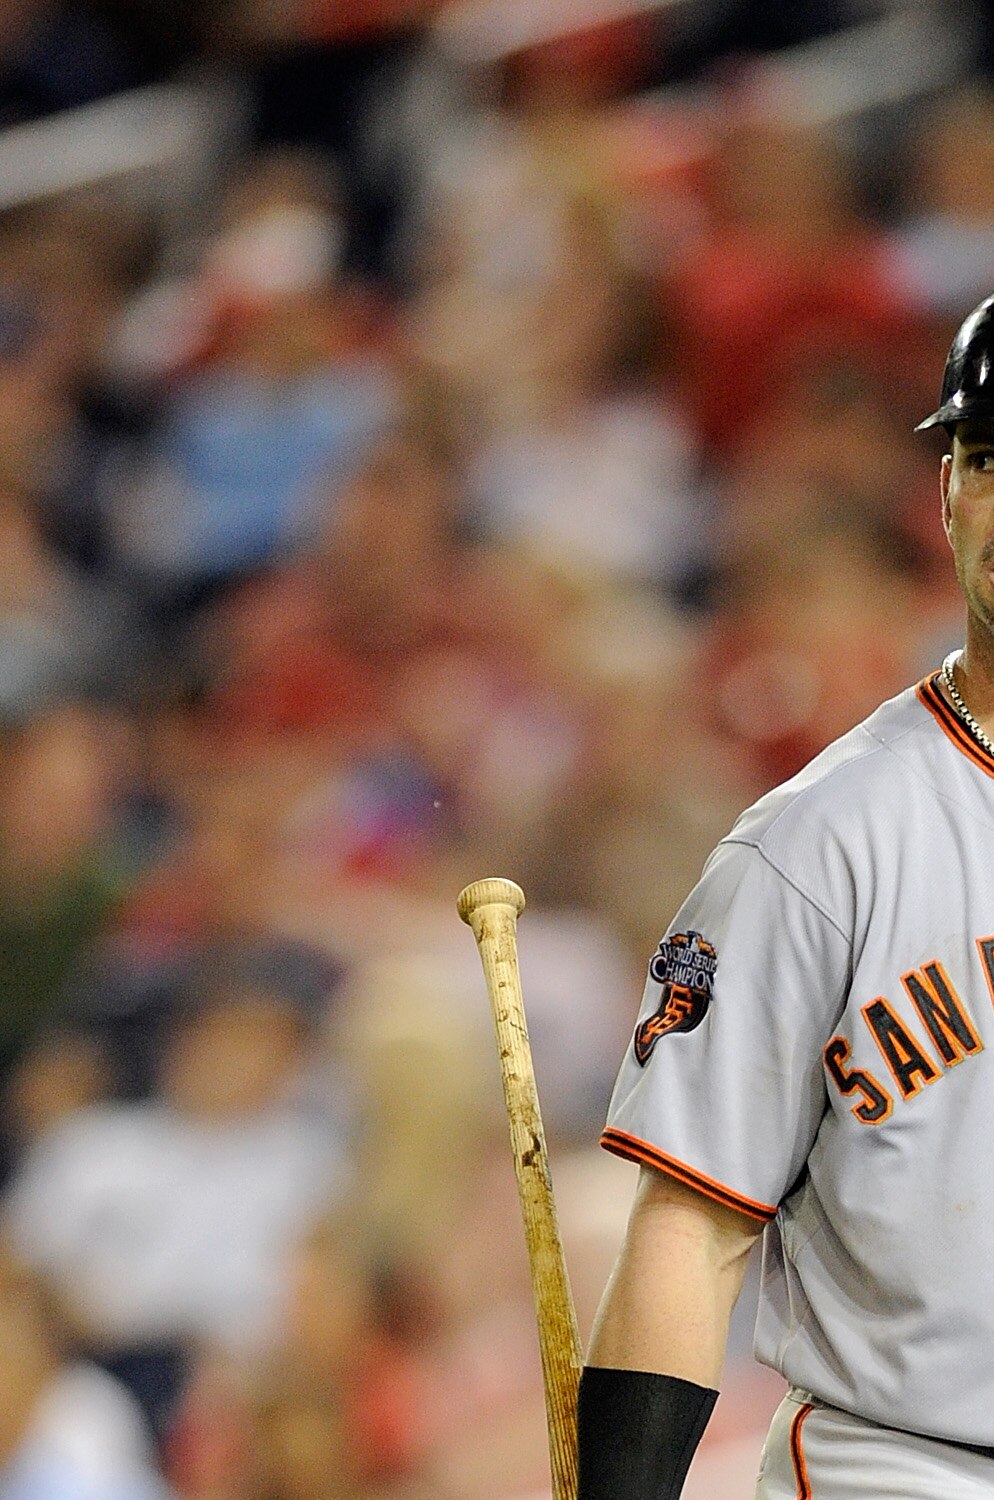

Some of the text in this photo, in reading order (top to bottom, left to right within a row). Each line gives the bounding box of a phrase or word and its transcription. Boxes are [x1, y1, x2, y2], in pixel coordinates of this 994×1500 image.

[661, 943, 718, 973] WORLD SERIE
[823, 959, 986, 1126] SAN
